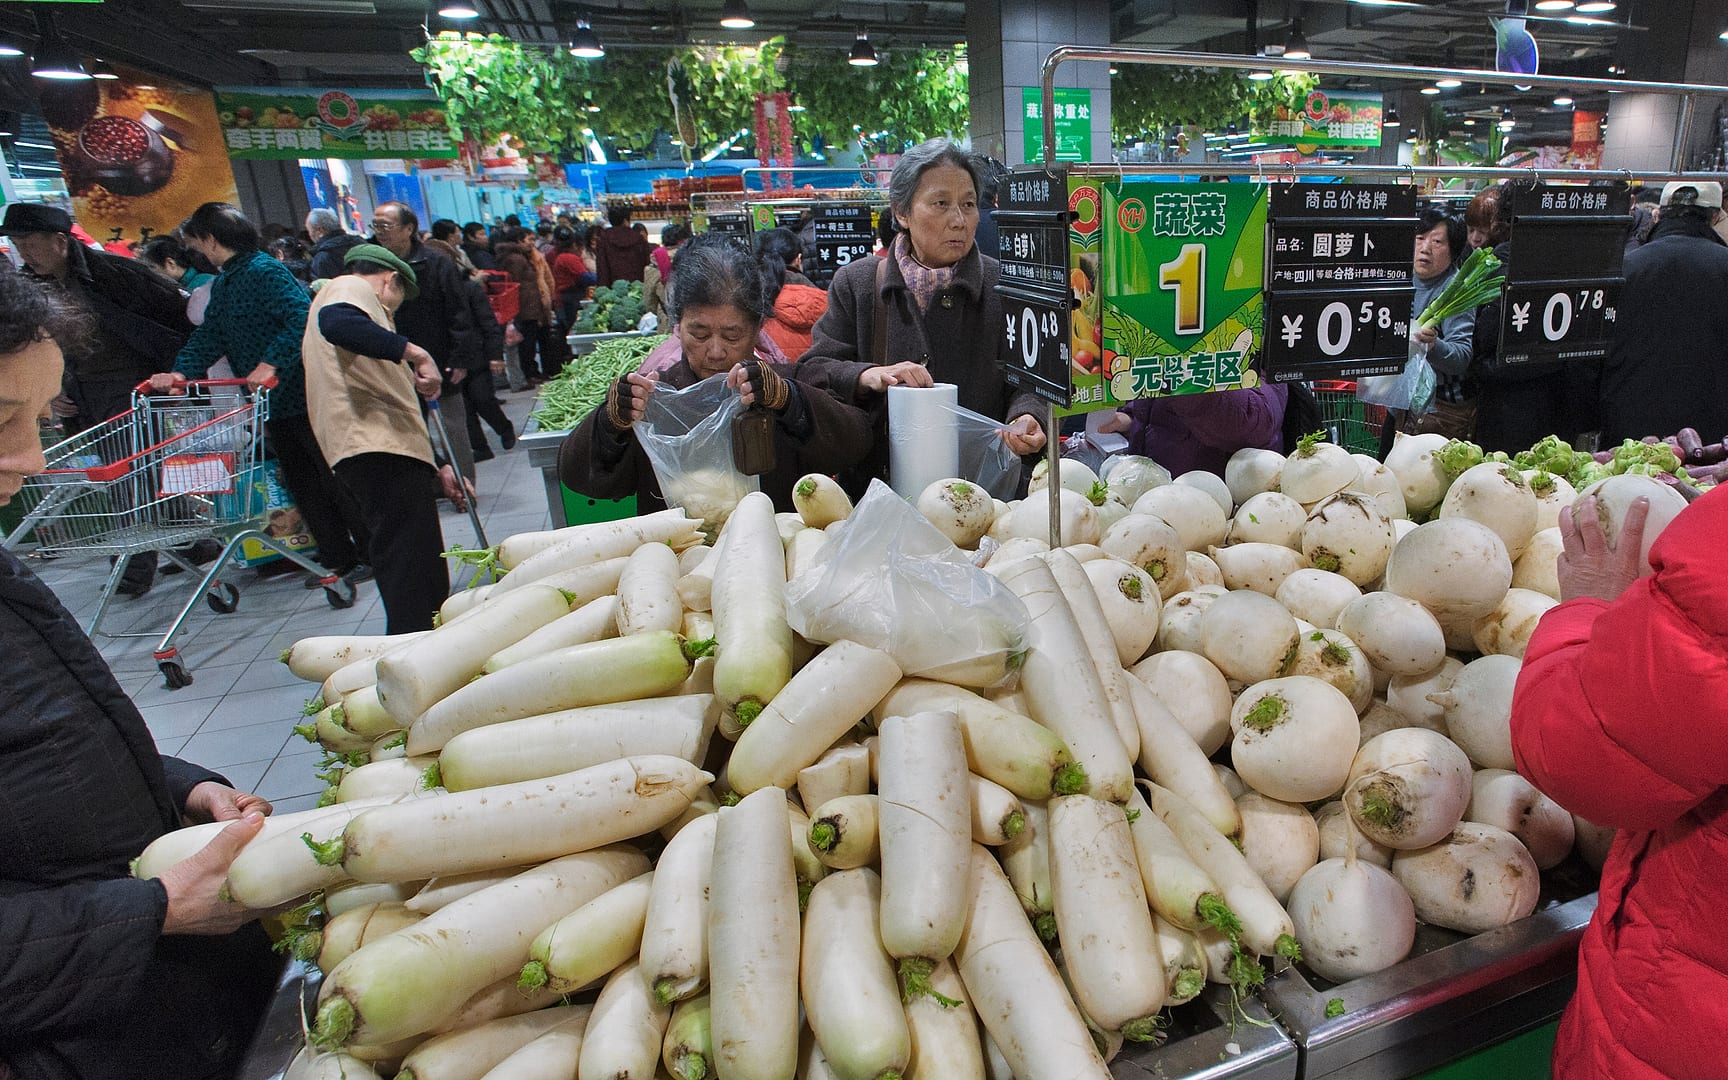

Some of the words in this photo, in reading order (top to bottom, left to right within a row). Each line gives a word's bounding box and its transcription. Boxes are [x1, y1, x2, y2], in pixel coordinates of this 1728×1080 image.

[1026, 102, 1090, 119] 蔬称重处
[362, 130, 452, 150] 共建民生
[1010, 180, 1049, 202] 商品价格牌
[1306, 190, 1388, 210] 商品价格牌
[1541, 192, 1608, 210] 商品价格牌
[1153, 193, 1226, 236] 蔬菜
[828, 222, 854, 231] 荷兰豆
[1014, 233, 1036, 259] 白萝卜
[1275, 238, 1304, 251] 品名:
[1312, 233, 1375, 257] 圆萝卜
[1159, 243, 1206, 335] 1
[1393, 321, 1408, 338] 500g
[265, 469, 282, 510] Pampers
